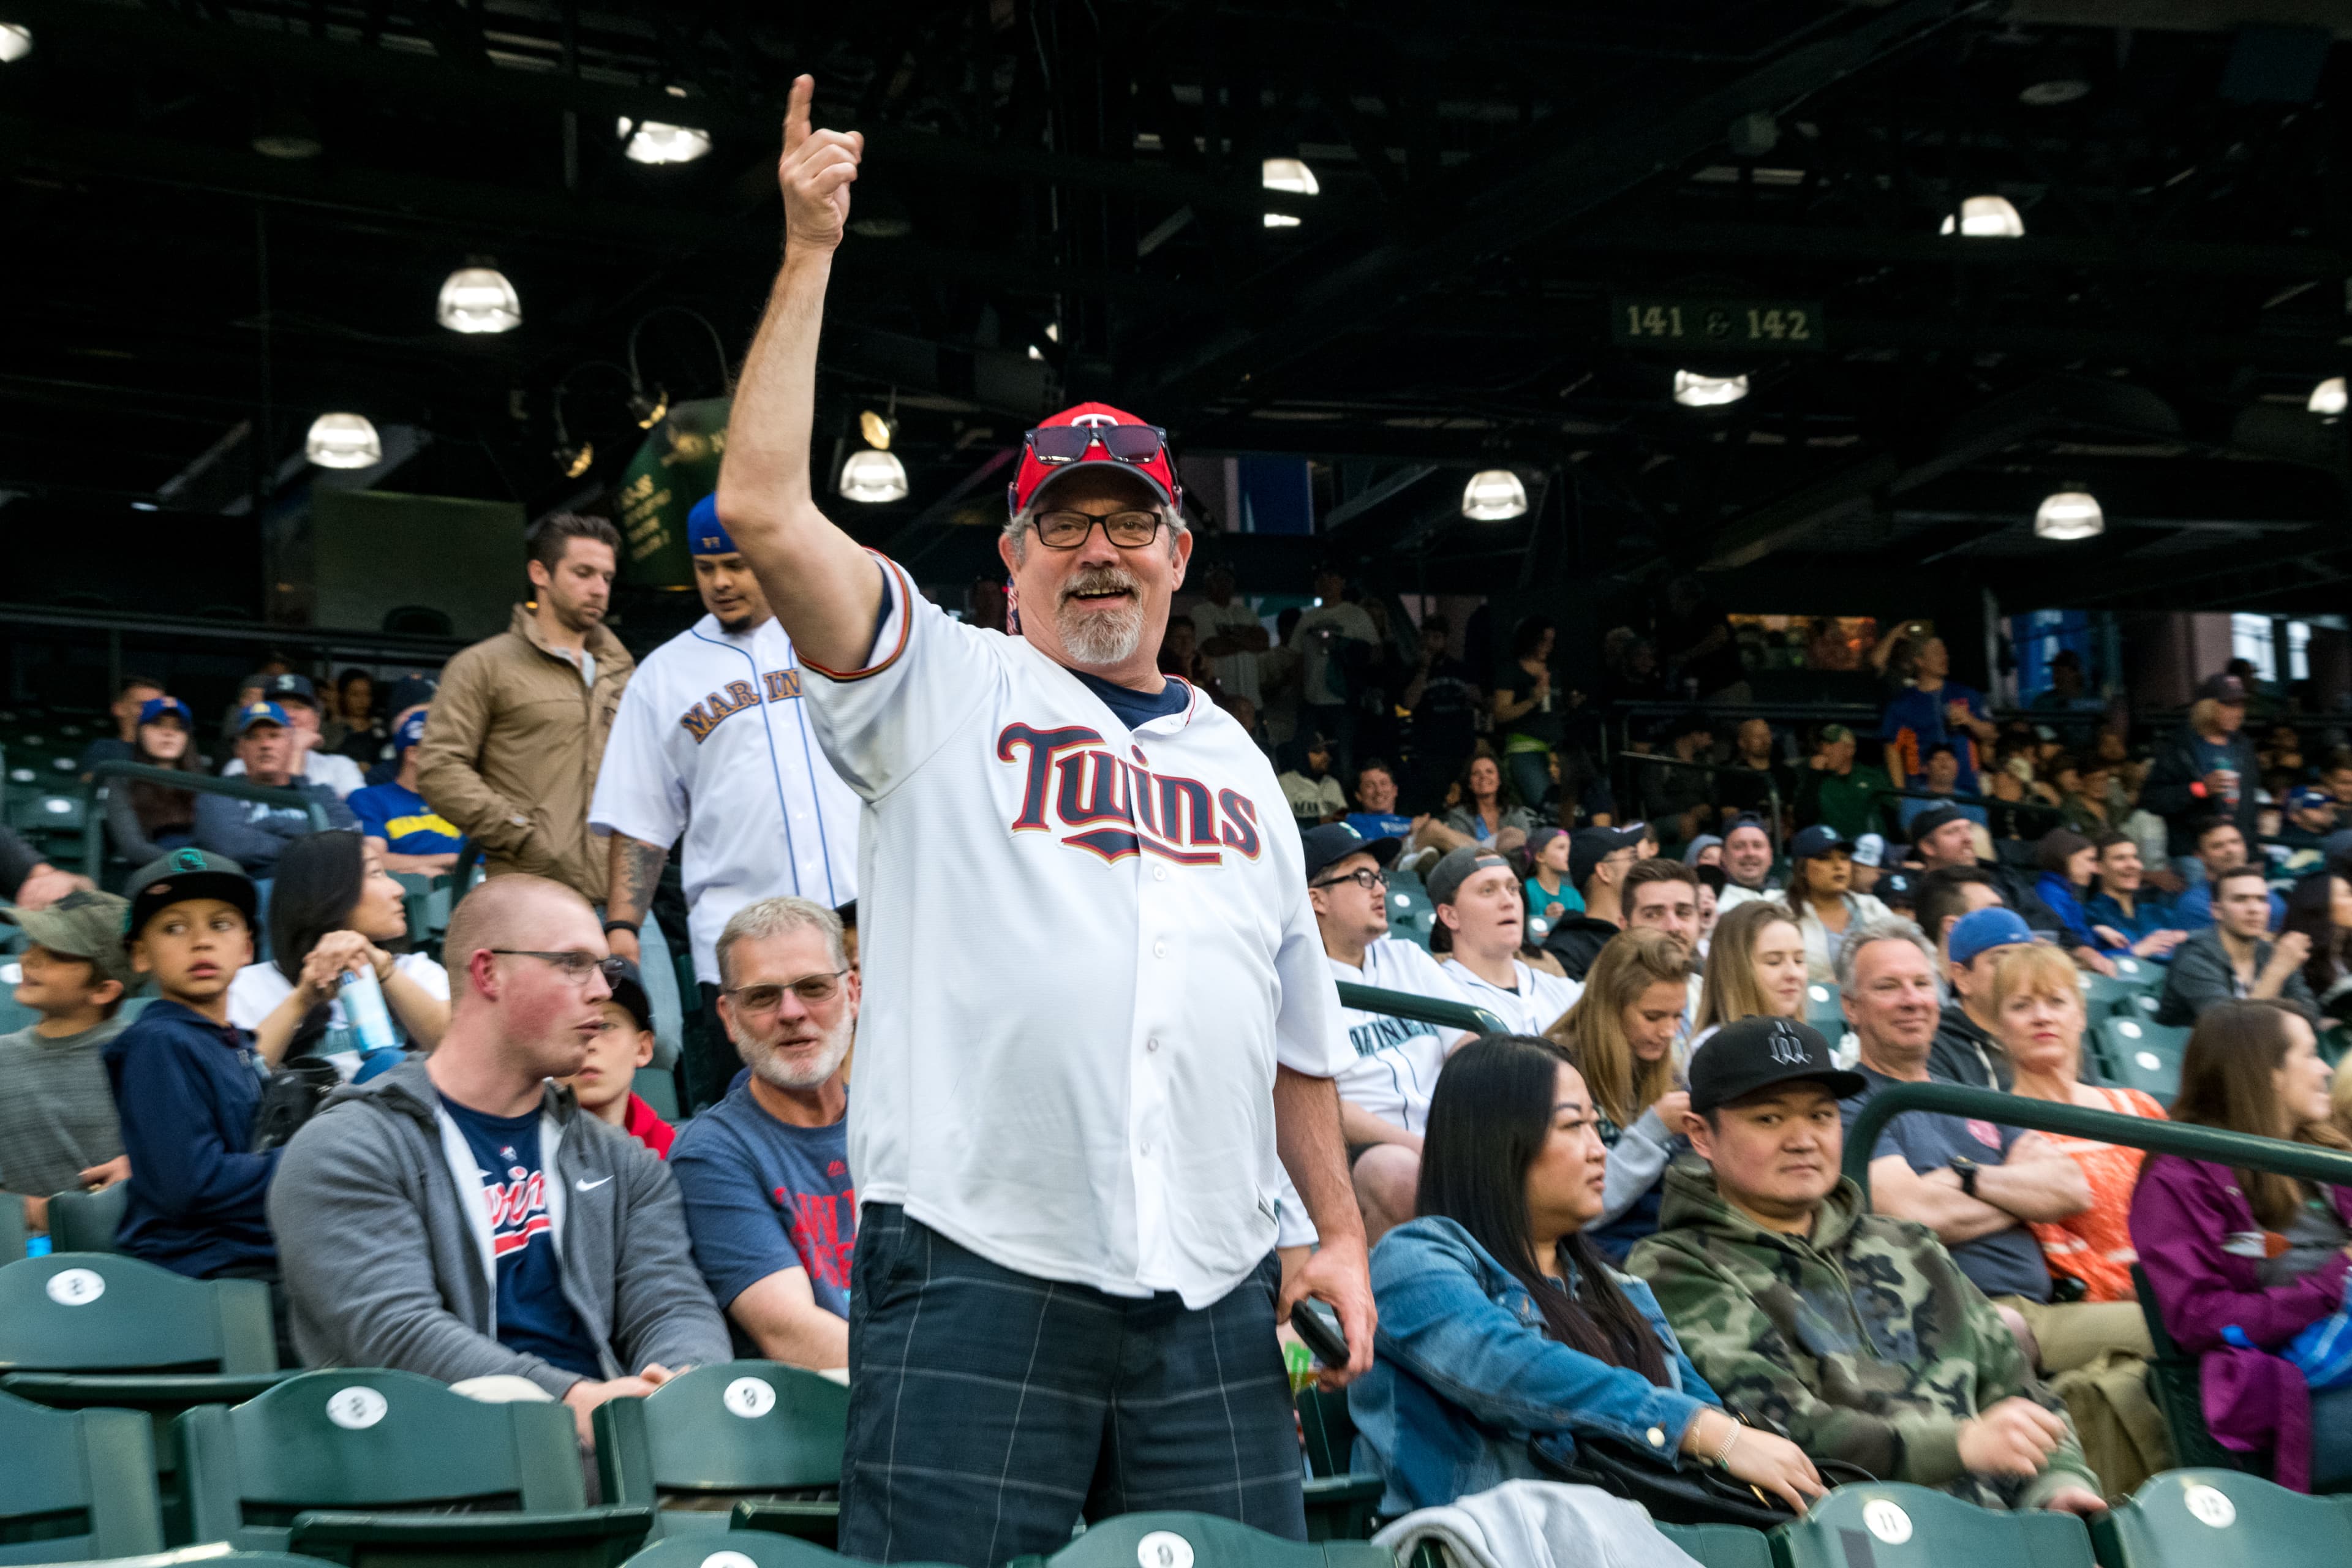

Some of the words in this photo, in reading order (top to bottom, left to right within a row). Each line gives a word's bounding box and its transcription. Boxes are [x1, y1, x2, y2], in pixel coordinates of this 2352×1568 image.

[1627, 306, 1683, 337] 141
[1706, 310, 1730, 338] &
[1747, 308, 1810, 340] 142
[997, 722, 1261, 865] Twins
